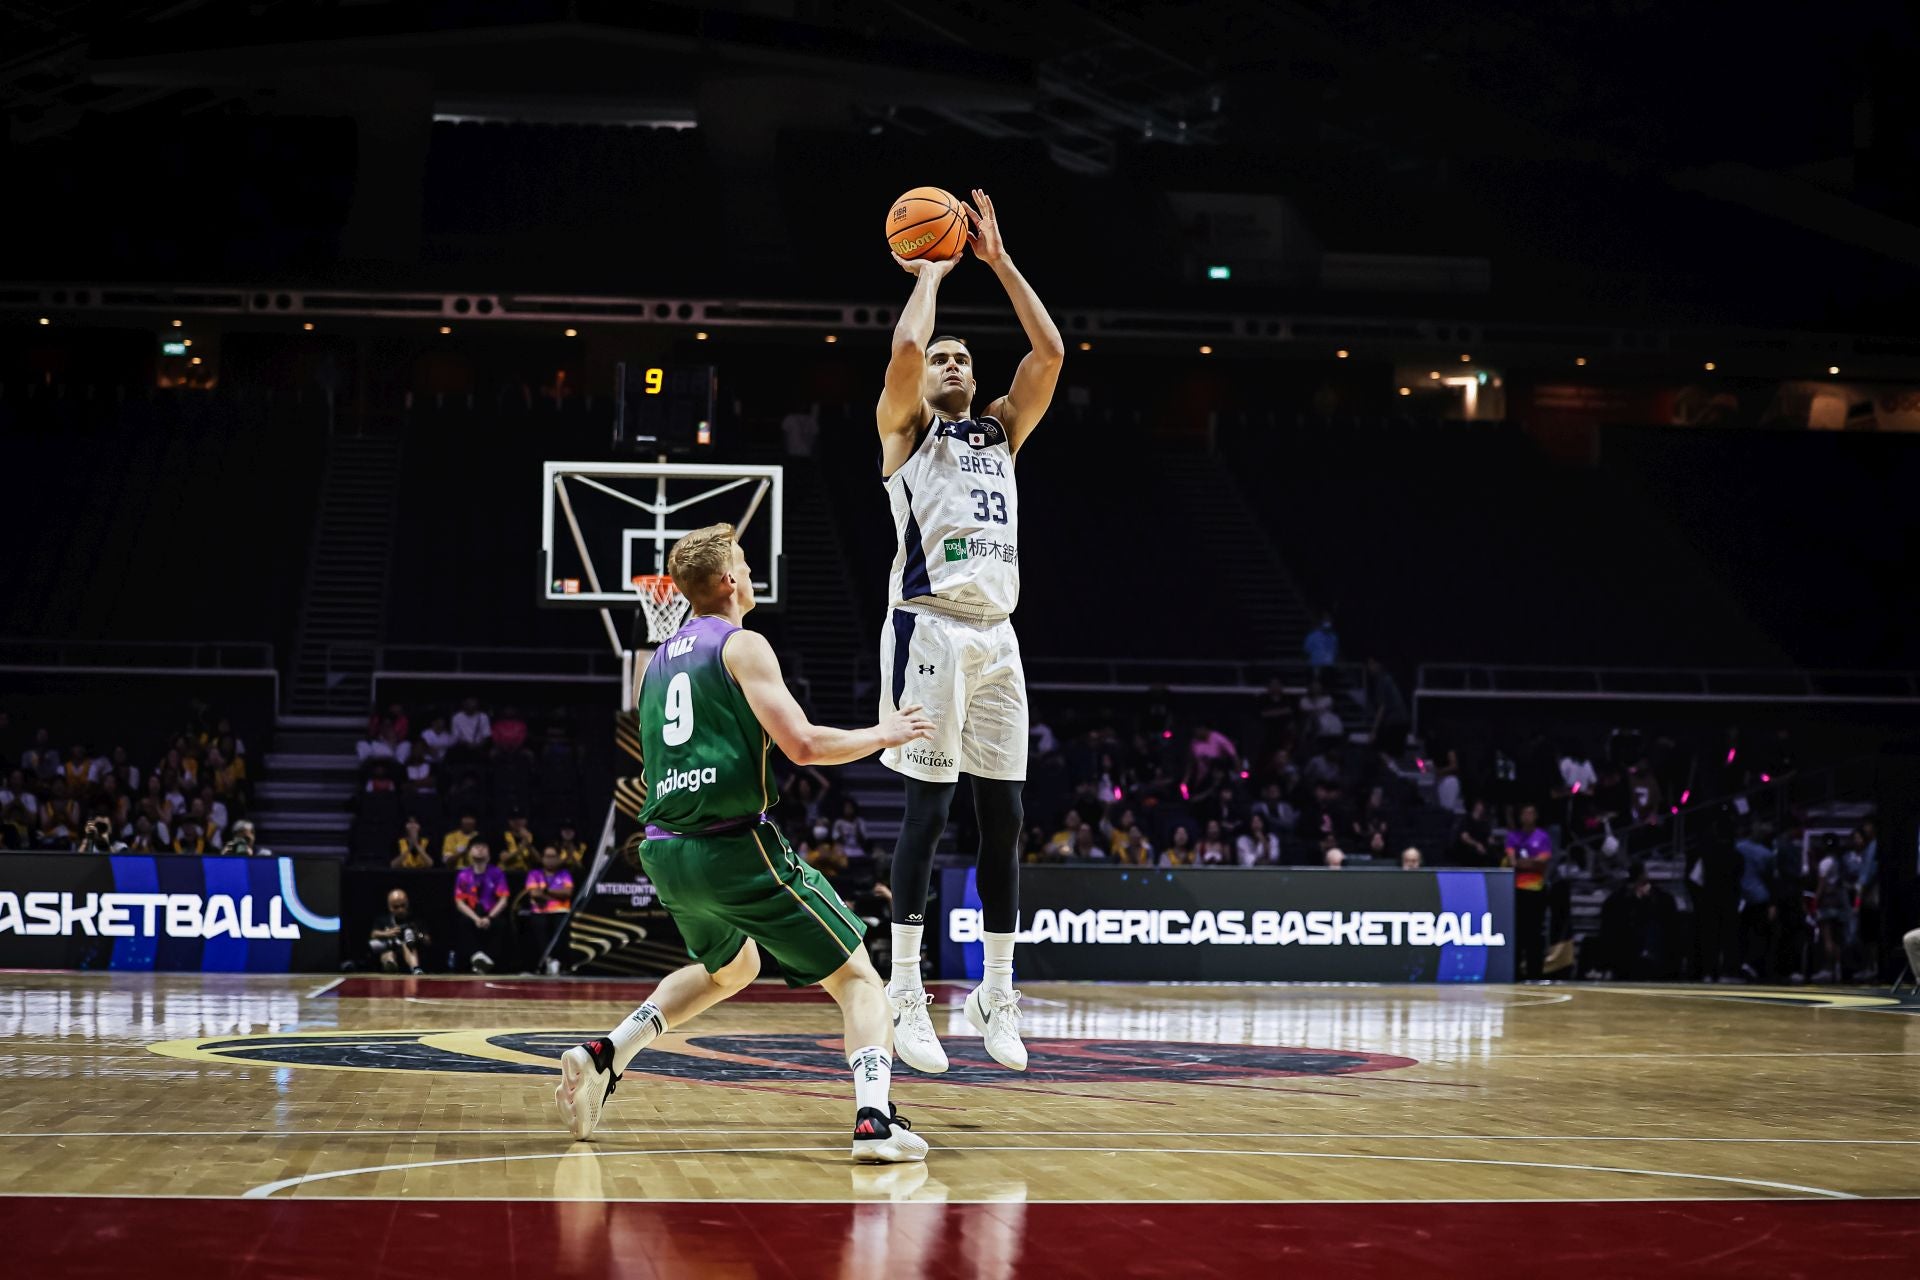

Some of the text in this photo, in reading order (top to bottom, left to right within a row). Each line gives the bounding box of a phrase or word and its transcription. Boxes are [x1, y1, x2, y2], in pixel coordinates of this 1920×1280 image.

[891, 232, 936, 254] Wilson
[645, 367, 664, 395] 9
[958, 456, 1005, 478] BREX
[970, 489, 1008, 525] 33
[662, 671, 695, 747] 9
[912, 753, 954, 768] NICIGAS
[656, 767, 717, 801] málaga
[0, 891, 301, 940] ASKETBALL
[630, 895, 652, 908] CUP
[949, 907, 1506, 947] BLAMERICAS.BASKETBALL
